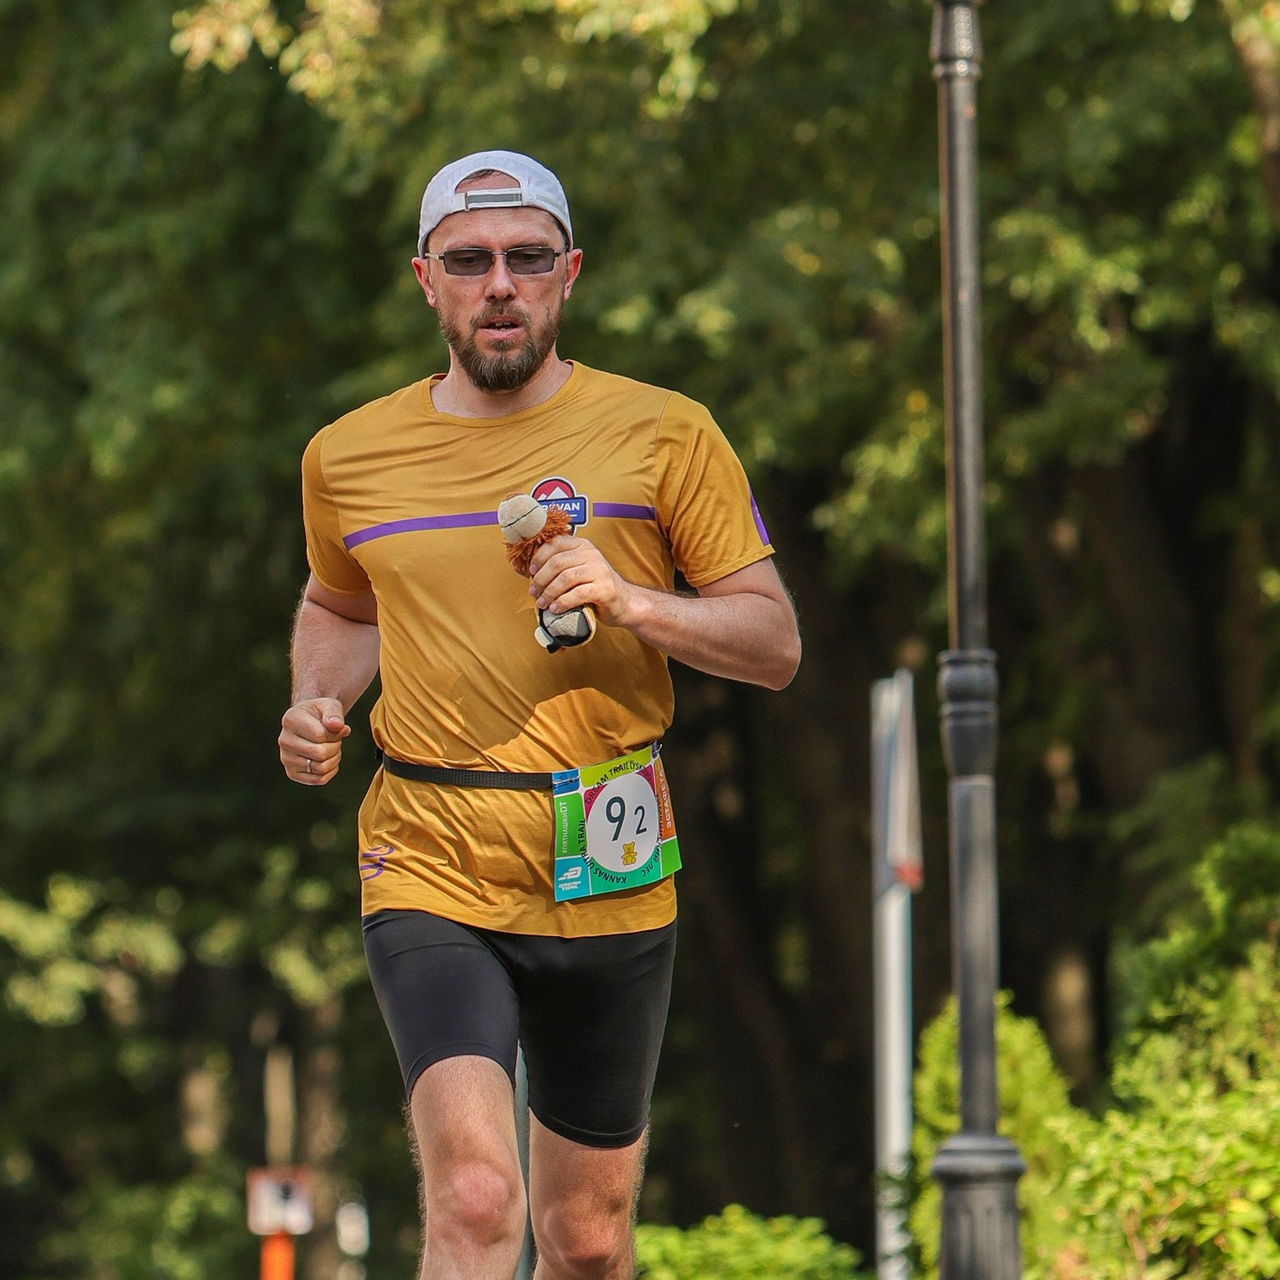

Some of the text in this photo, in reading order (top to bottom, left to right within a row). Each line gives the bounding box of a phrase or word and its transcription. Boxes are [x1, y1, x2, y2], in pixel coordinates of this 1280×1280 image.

[586, 773, 609, 805] DREAM
[577, 819, 586, 845] TRAIL
[593, 867, 627, 884] KANNAS
